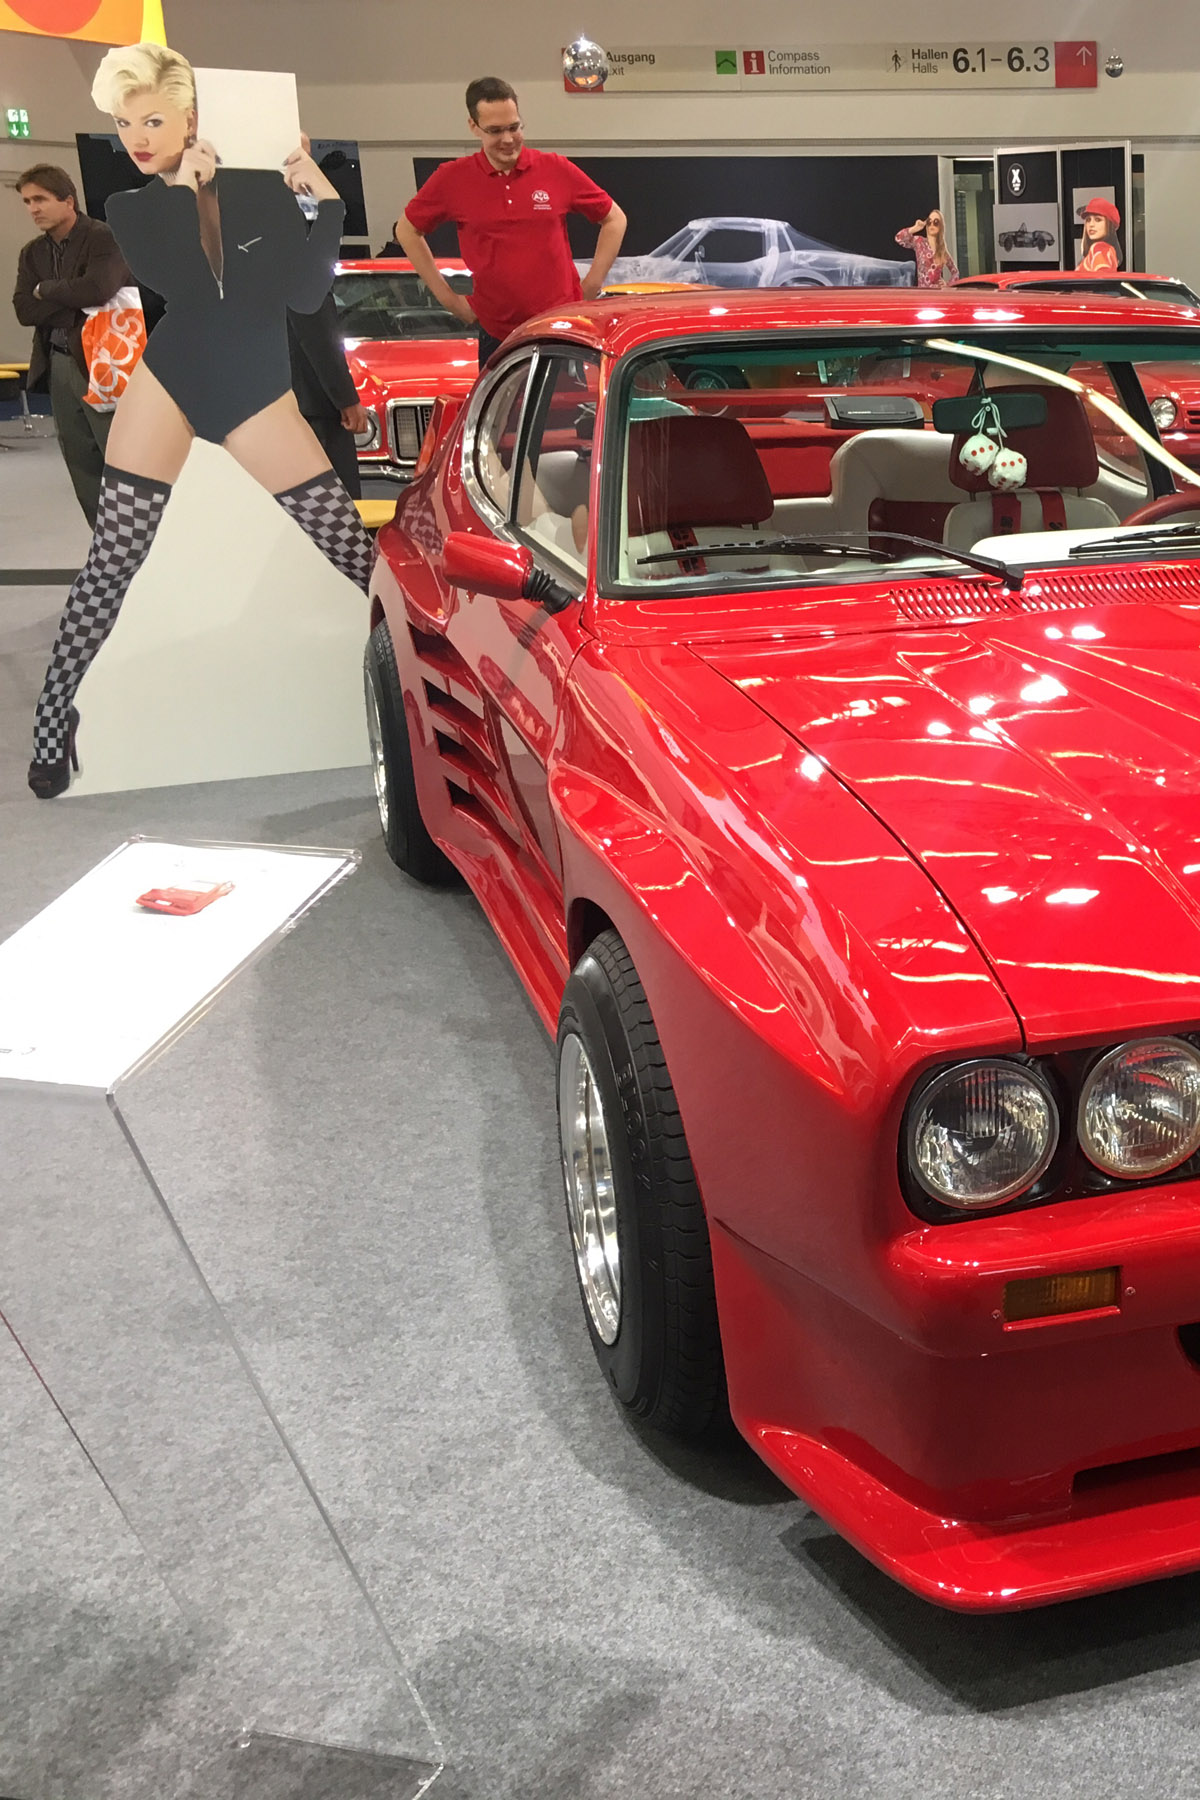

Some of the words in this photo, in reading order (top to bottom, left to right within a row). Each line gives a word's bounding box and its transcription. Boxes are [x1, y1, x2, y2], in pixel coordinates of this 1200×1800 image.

[606, 51, 656, 64] Ausgang
[767, 50, 820, 62] Compass
[911, 49, 949, 60] Hallen
[768, 64, 831, 75] Information
[912, 63, 939, 73] Halls
